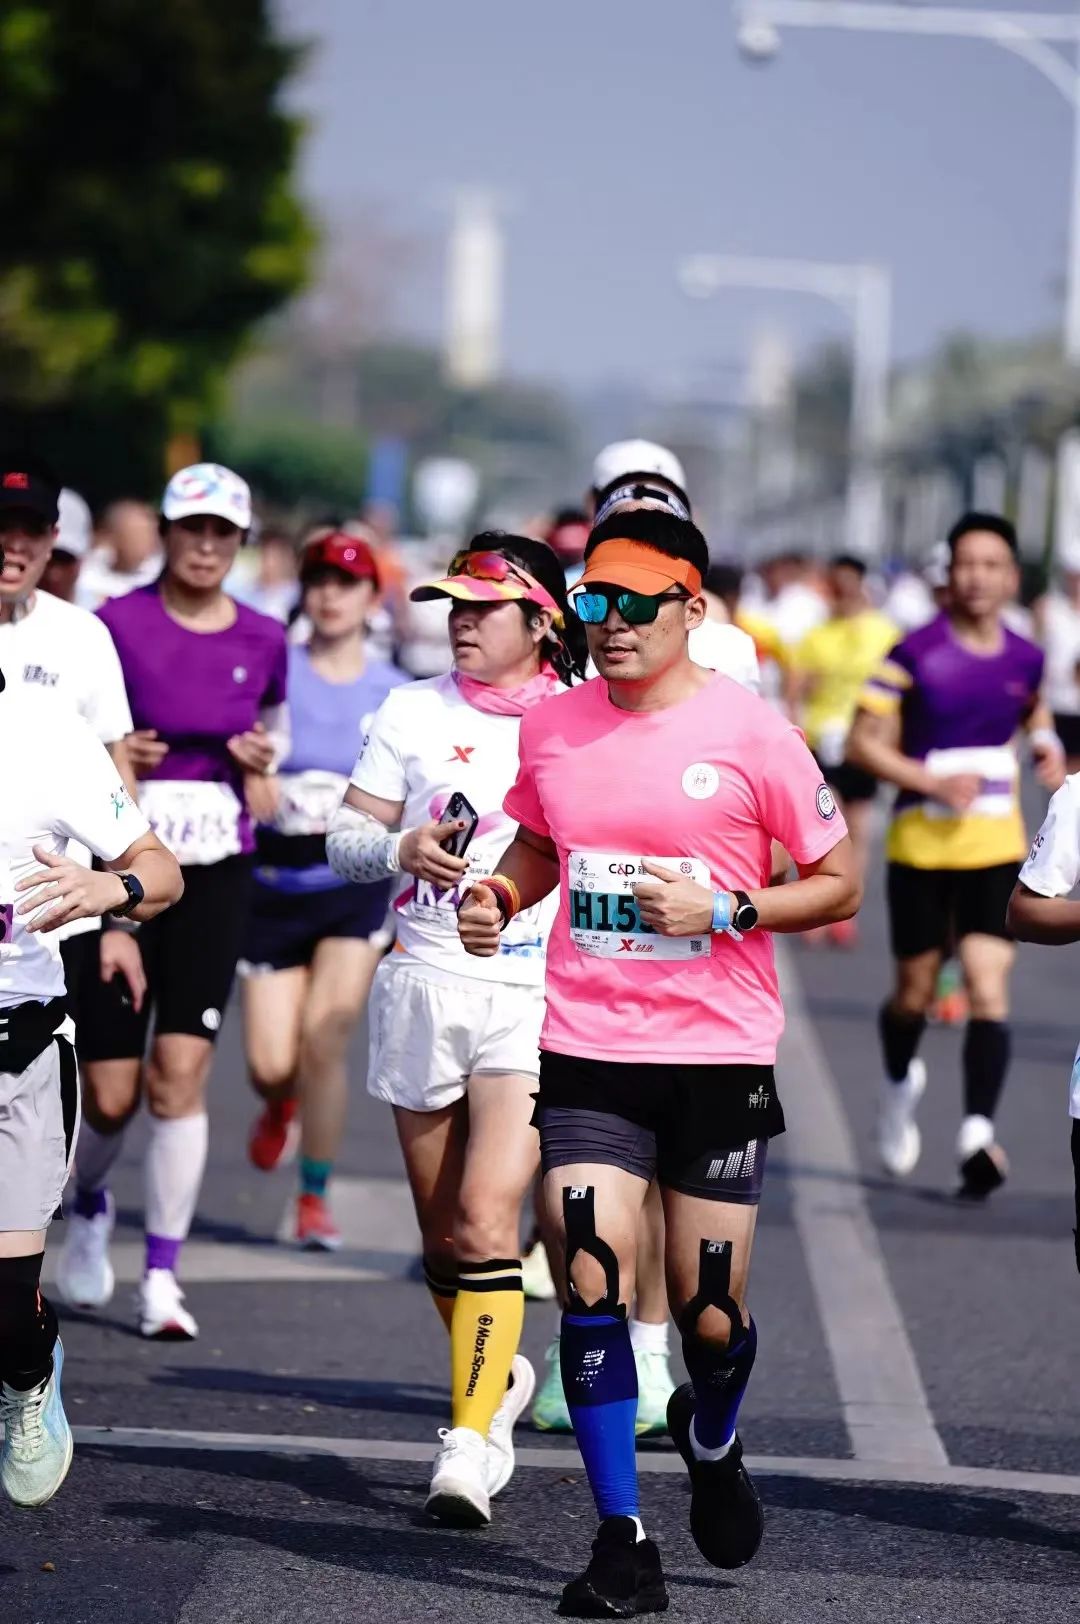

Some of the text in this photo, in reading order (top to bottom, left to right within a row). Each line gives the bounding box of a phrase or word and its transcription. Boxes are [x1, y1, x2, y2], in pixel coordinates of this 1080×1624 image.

[608, 862, 636, 877] C&D
[416, 878, 474, 911] K2
[573, 891, 658, 933] H15
[748, 1086, 770, 1109] 神行
